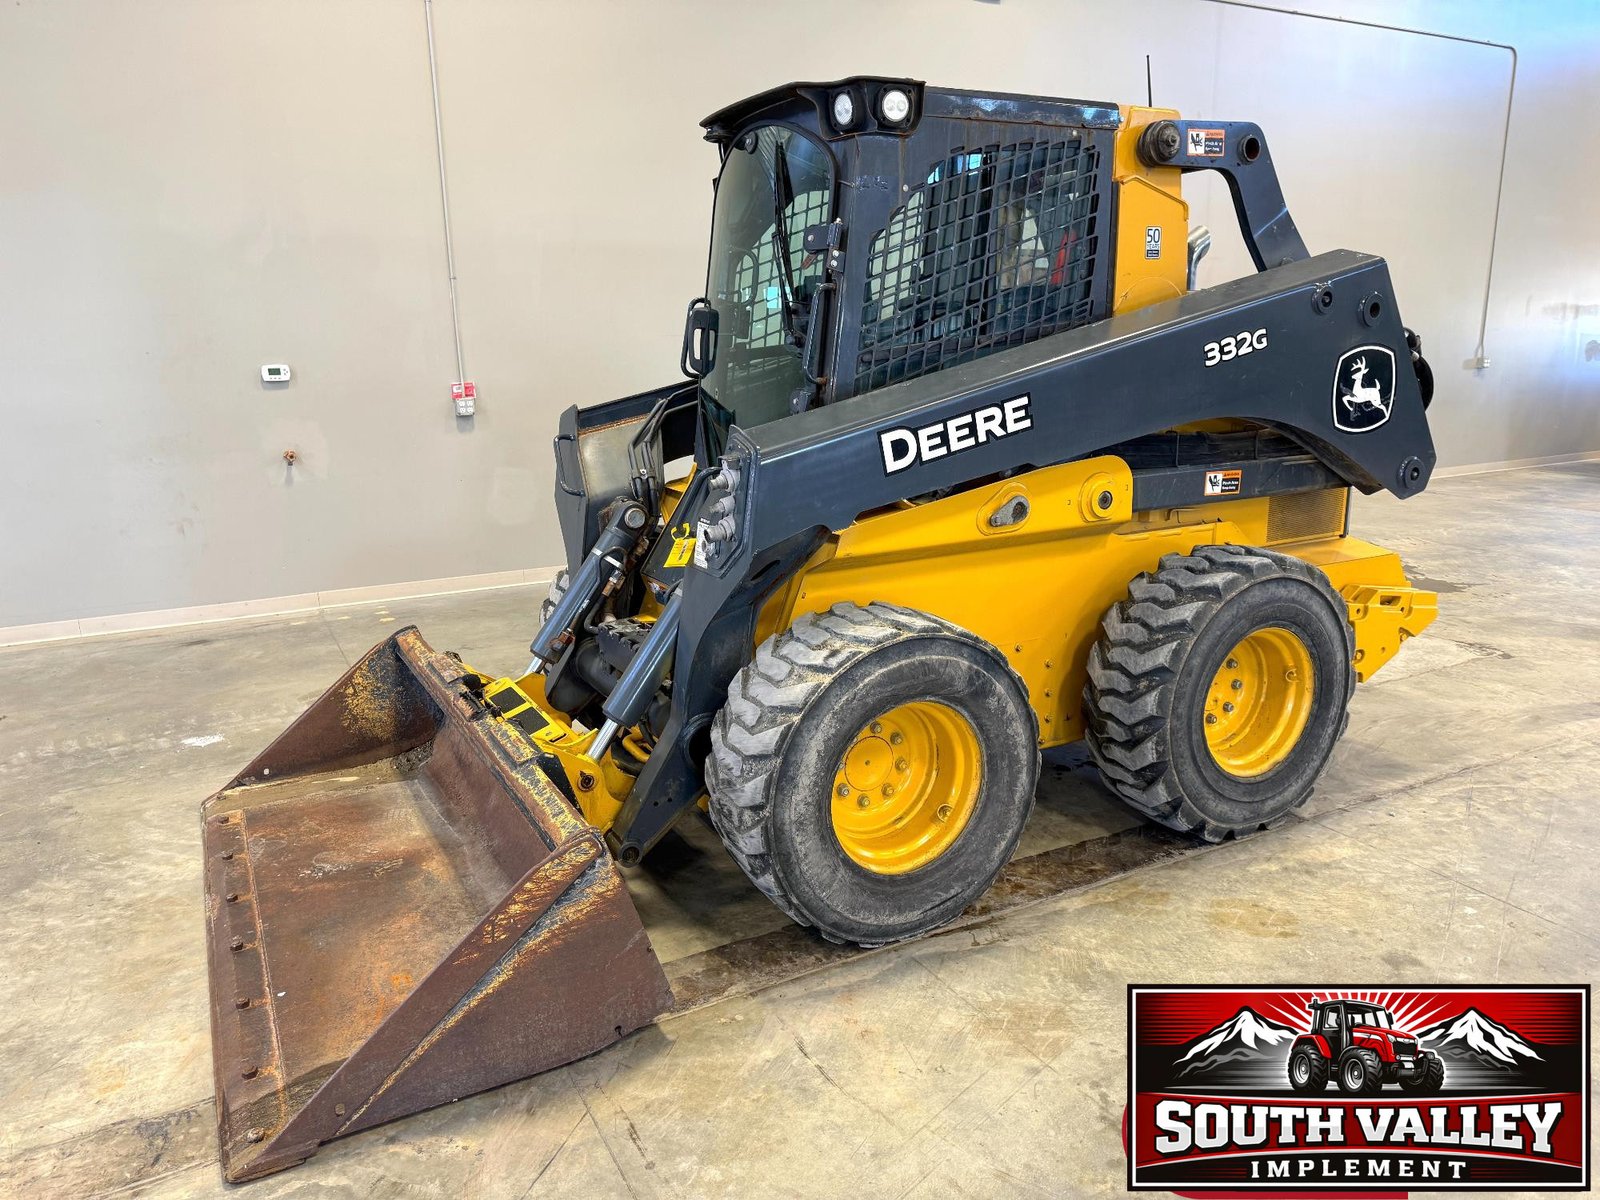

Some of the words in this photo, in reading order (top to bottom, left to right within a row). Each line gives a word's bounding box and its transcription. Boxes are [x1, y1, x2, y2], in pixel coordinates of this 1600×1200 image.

[1147, 228, 1160, 243] 50
[1204, 328, 1268, 367] 332G
[880, 395, 1032, 474] DEERE
